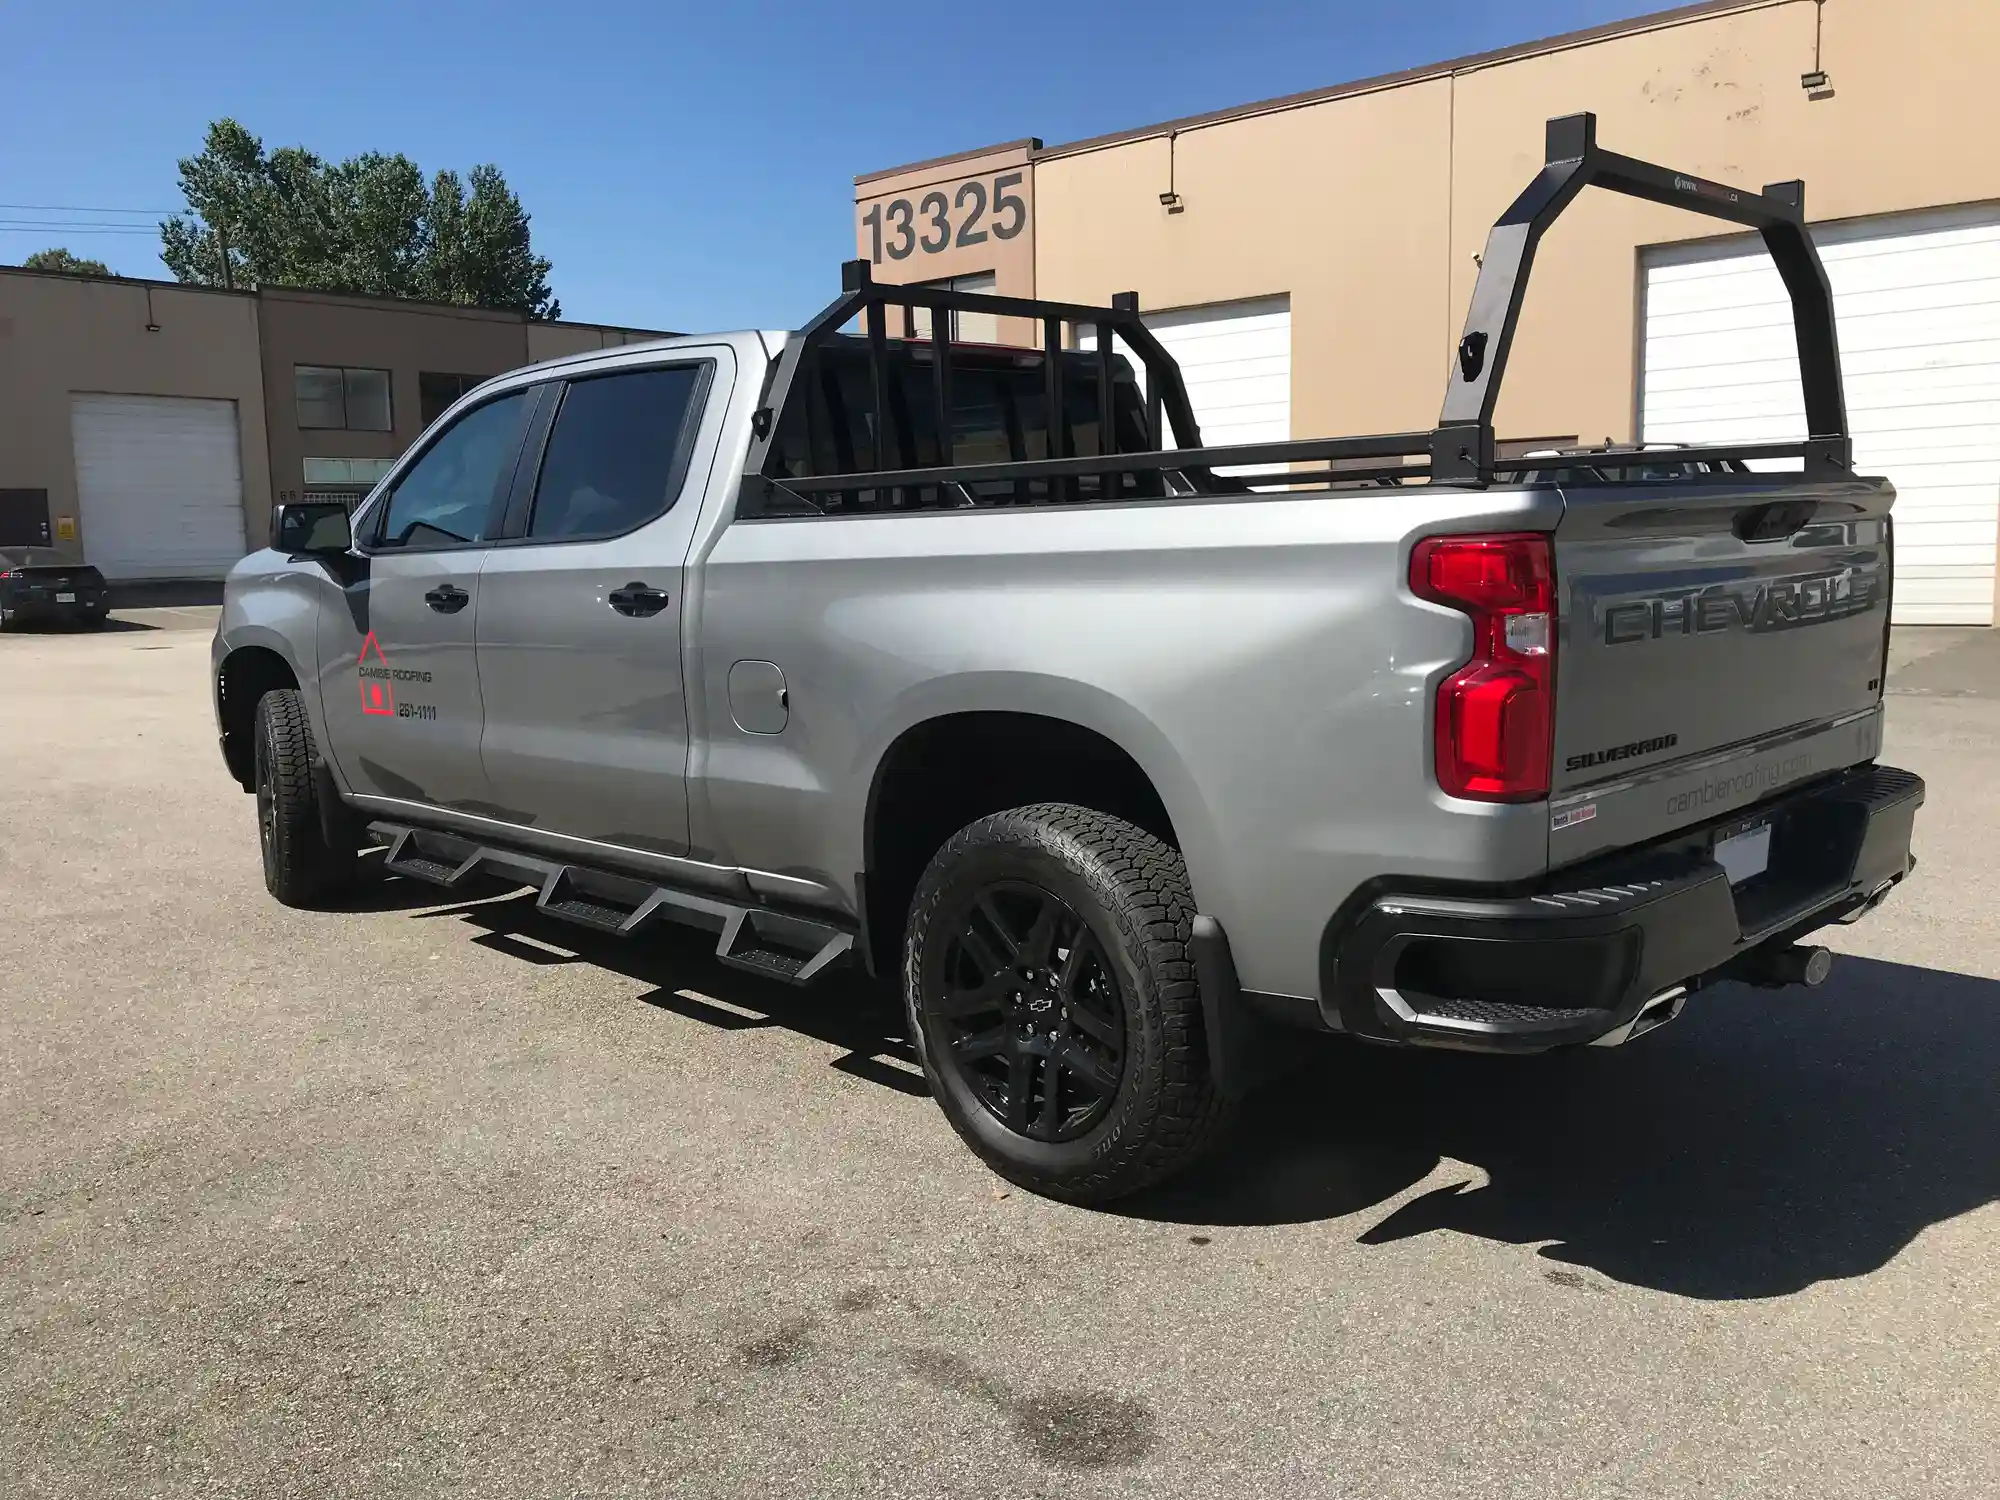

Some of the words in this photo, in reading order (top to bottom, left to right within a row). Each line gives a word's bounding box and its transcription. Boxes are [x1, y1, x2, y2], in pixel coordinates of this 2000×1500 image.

[862, 172, 1027, 265] 13325
[358, 667, 390, 680] CAMBIE
[392, 669, 432, 683] ROOFING
[1565, 733, 1678, 772] SILVERADO
[1666, 753, 1813, 816] cambieroofing.com
